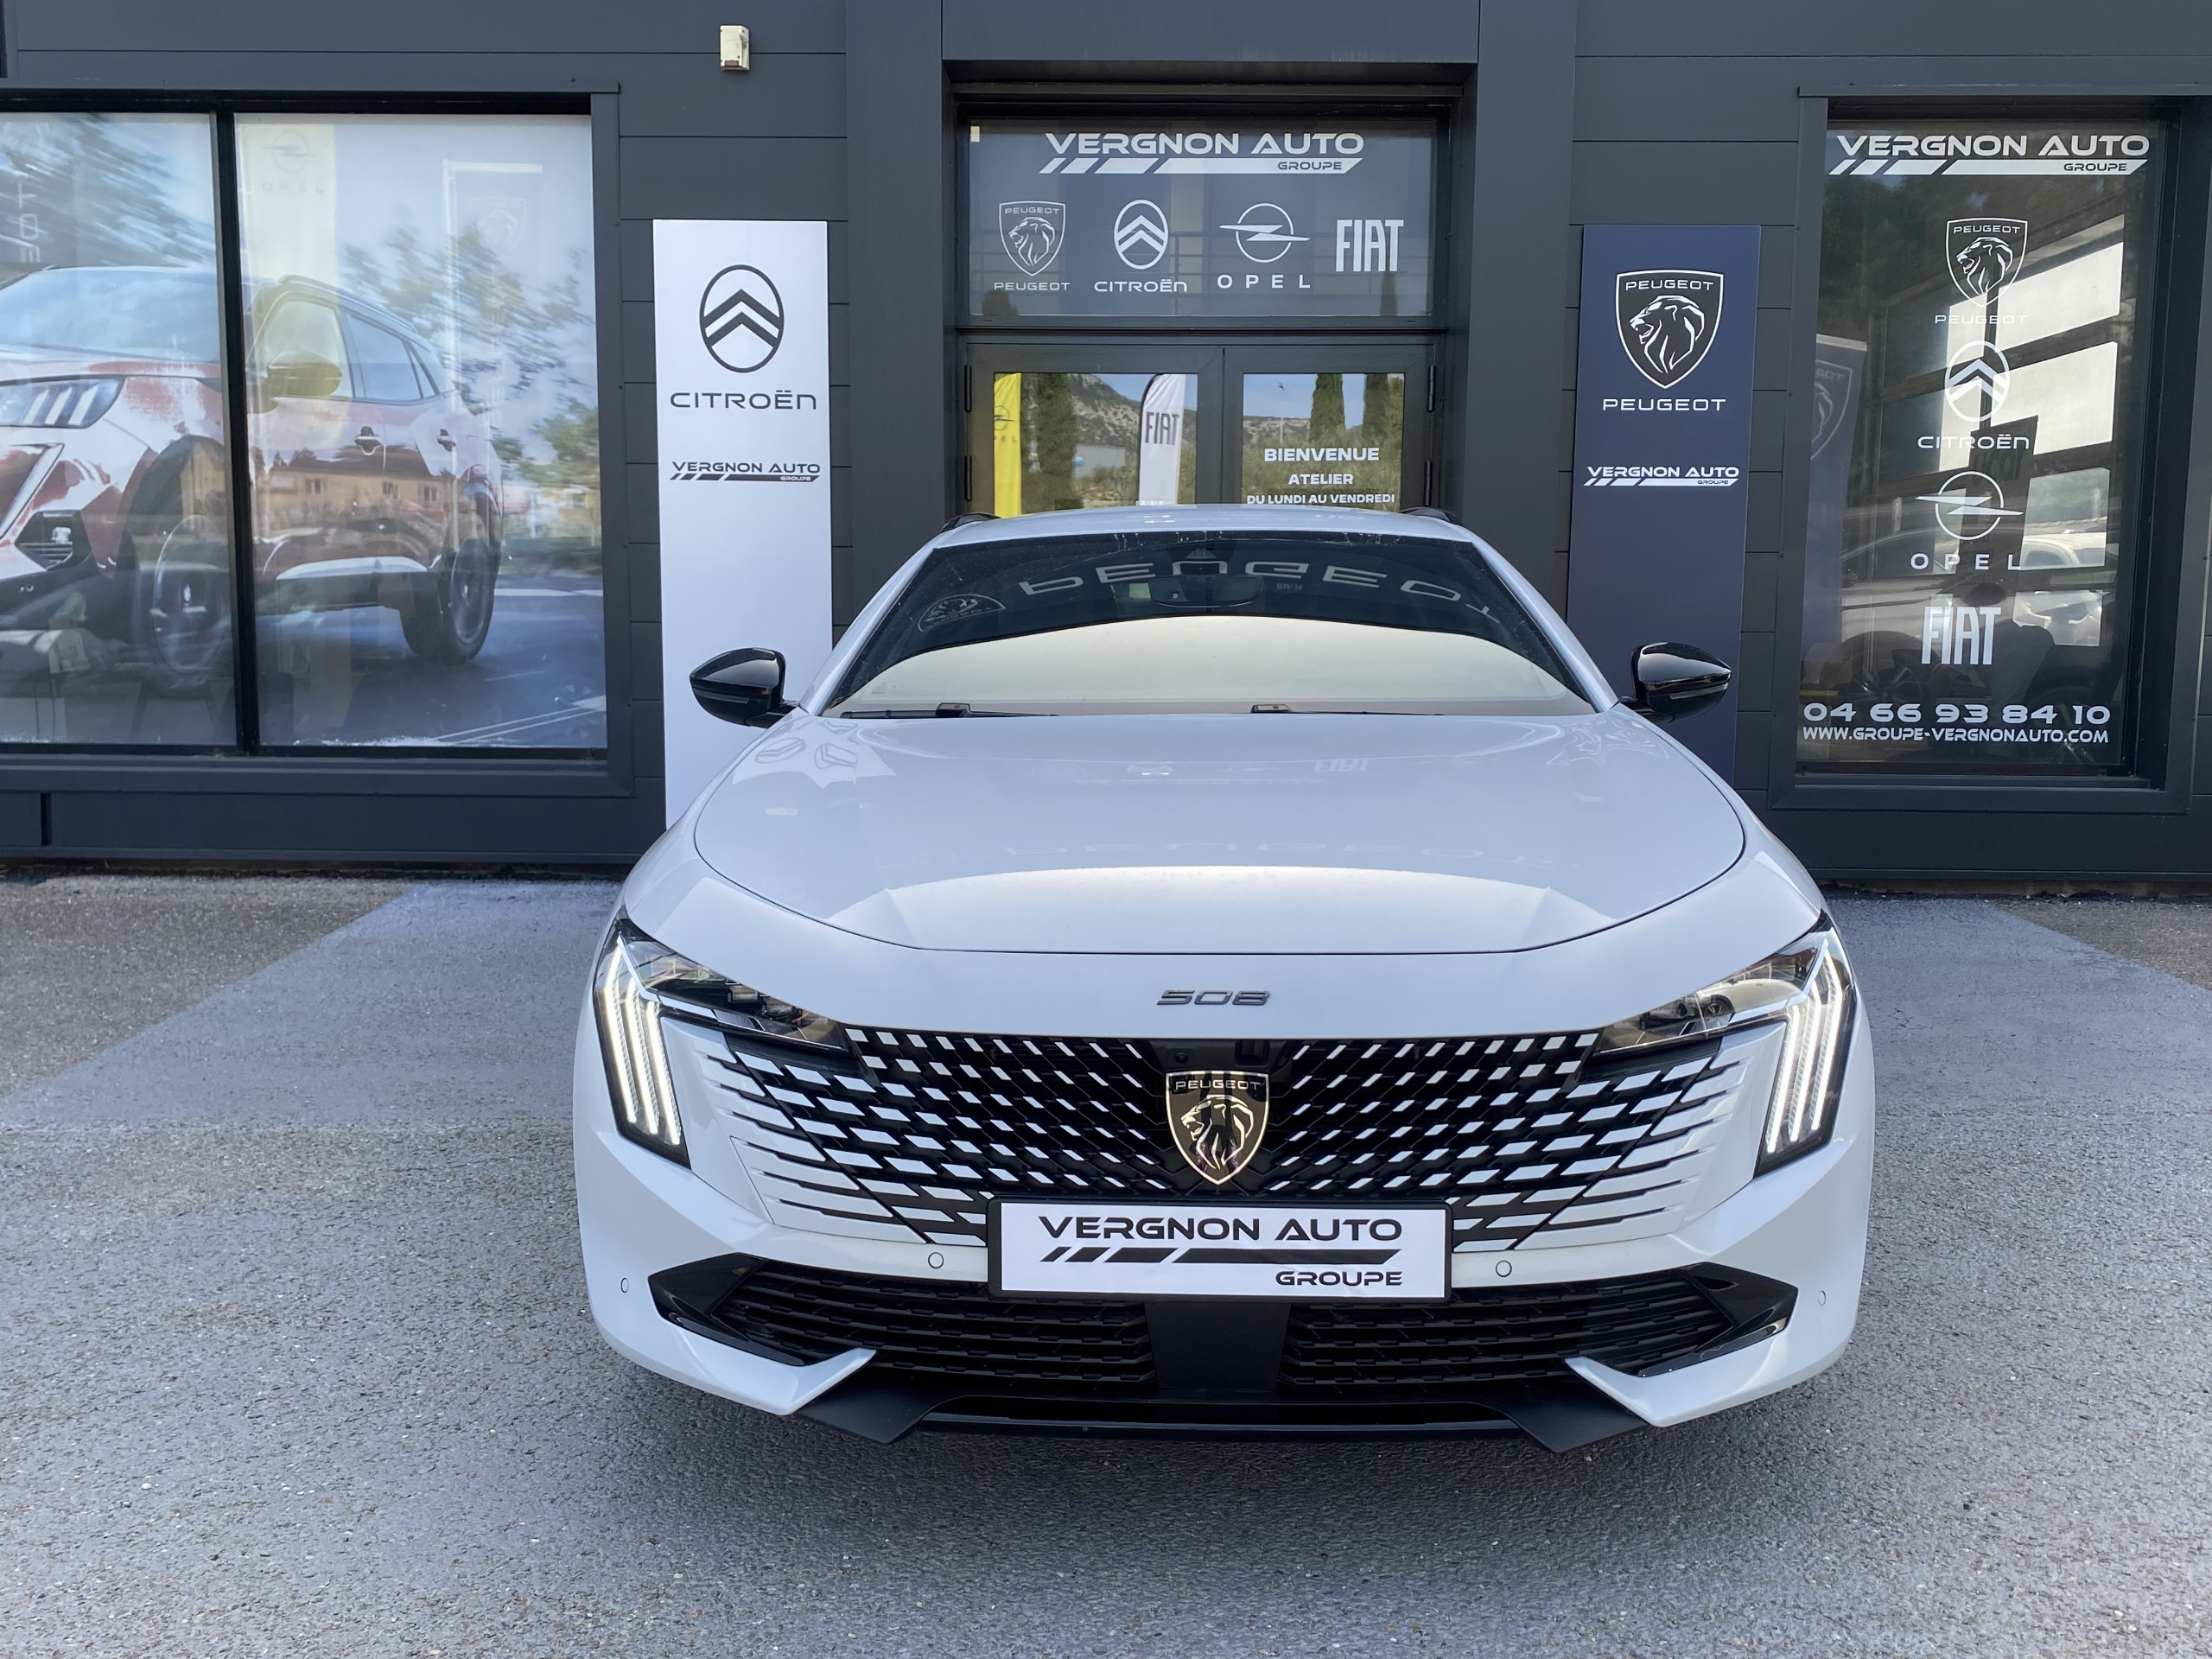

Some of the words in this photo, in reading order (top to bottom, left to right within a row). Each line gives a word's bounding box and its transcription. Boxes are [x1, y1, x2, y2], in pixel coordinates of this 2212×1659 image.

[1046, 133, 1239, 155] VERGNON
[1251, 133, 1364, 155] AUTO
[1836, 135, 2028, 156] VERGNON
[2037, 135, 2150, 156] AUTO
[1278, 162, 1342, 170] GROUPE
[2063, 163, 2127, 172] GROUPE
[1005, 207, 1060, 215] PEUGEOT
[1953, 225, 2021, 234] PEUGEOT
[1336, 219, 1404, 271] FIAT
[994, 282, 1071, 291] PEUGEOT
[1217, 274, 1311, 289] OPEL
[1625, 279, 1714, 291] PEUGEOT
[1935, 315, 2029, 325] PEUGEOT
[1602, 398, 1726, 411] PEUGEOT
[1145, 411, 1180, 445] FIAT
[1264, 448, 1380, 461] BIENVENUE
[671, 461, 762, 473] VERGNON
[768, 462, 820, 474] AUTO
[1587, 467, 1680, 477] VERGNON
[1685, 467, 1739, 478] AUTO
[1287, 474, 1354, 485] ATELIER
[1247, 494, 1263, 504] DU
[1267, 494, 1306, 504] LUNDI
[1308, 494, 1327, 504] AU
[1330, 493, 1395, 504] VENDREDI
[1910, 553, 2022, 571] OPEL
[1921, 607, 2001, 665] FIAT
[1803, 702, 1856, 722] 04
[1870, 703, 1923, 723] 66
[1936, 704, 1988, 723] 93
[2002, 705, 2057, 724] 84
[2073, 706, 2110, 725] 10
[1802, 727, 2108, 743] WWW.GROUPE-VERGNONAUTO.COM
[1157, 989, 1271, 1006] 508
[1175, 1080, 1261, 1090] PEUGEOT
[1039, 1217, 1259, 1241] VERGNON
[1274, 1218, 1402, 1242] AUTO
[1275, 1271, 1402, 1287] GROUPE
